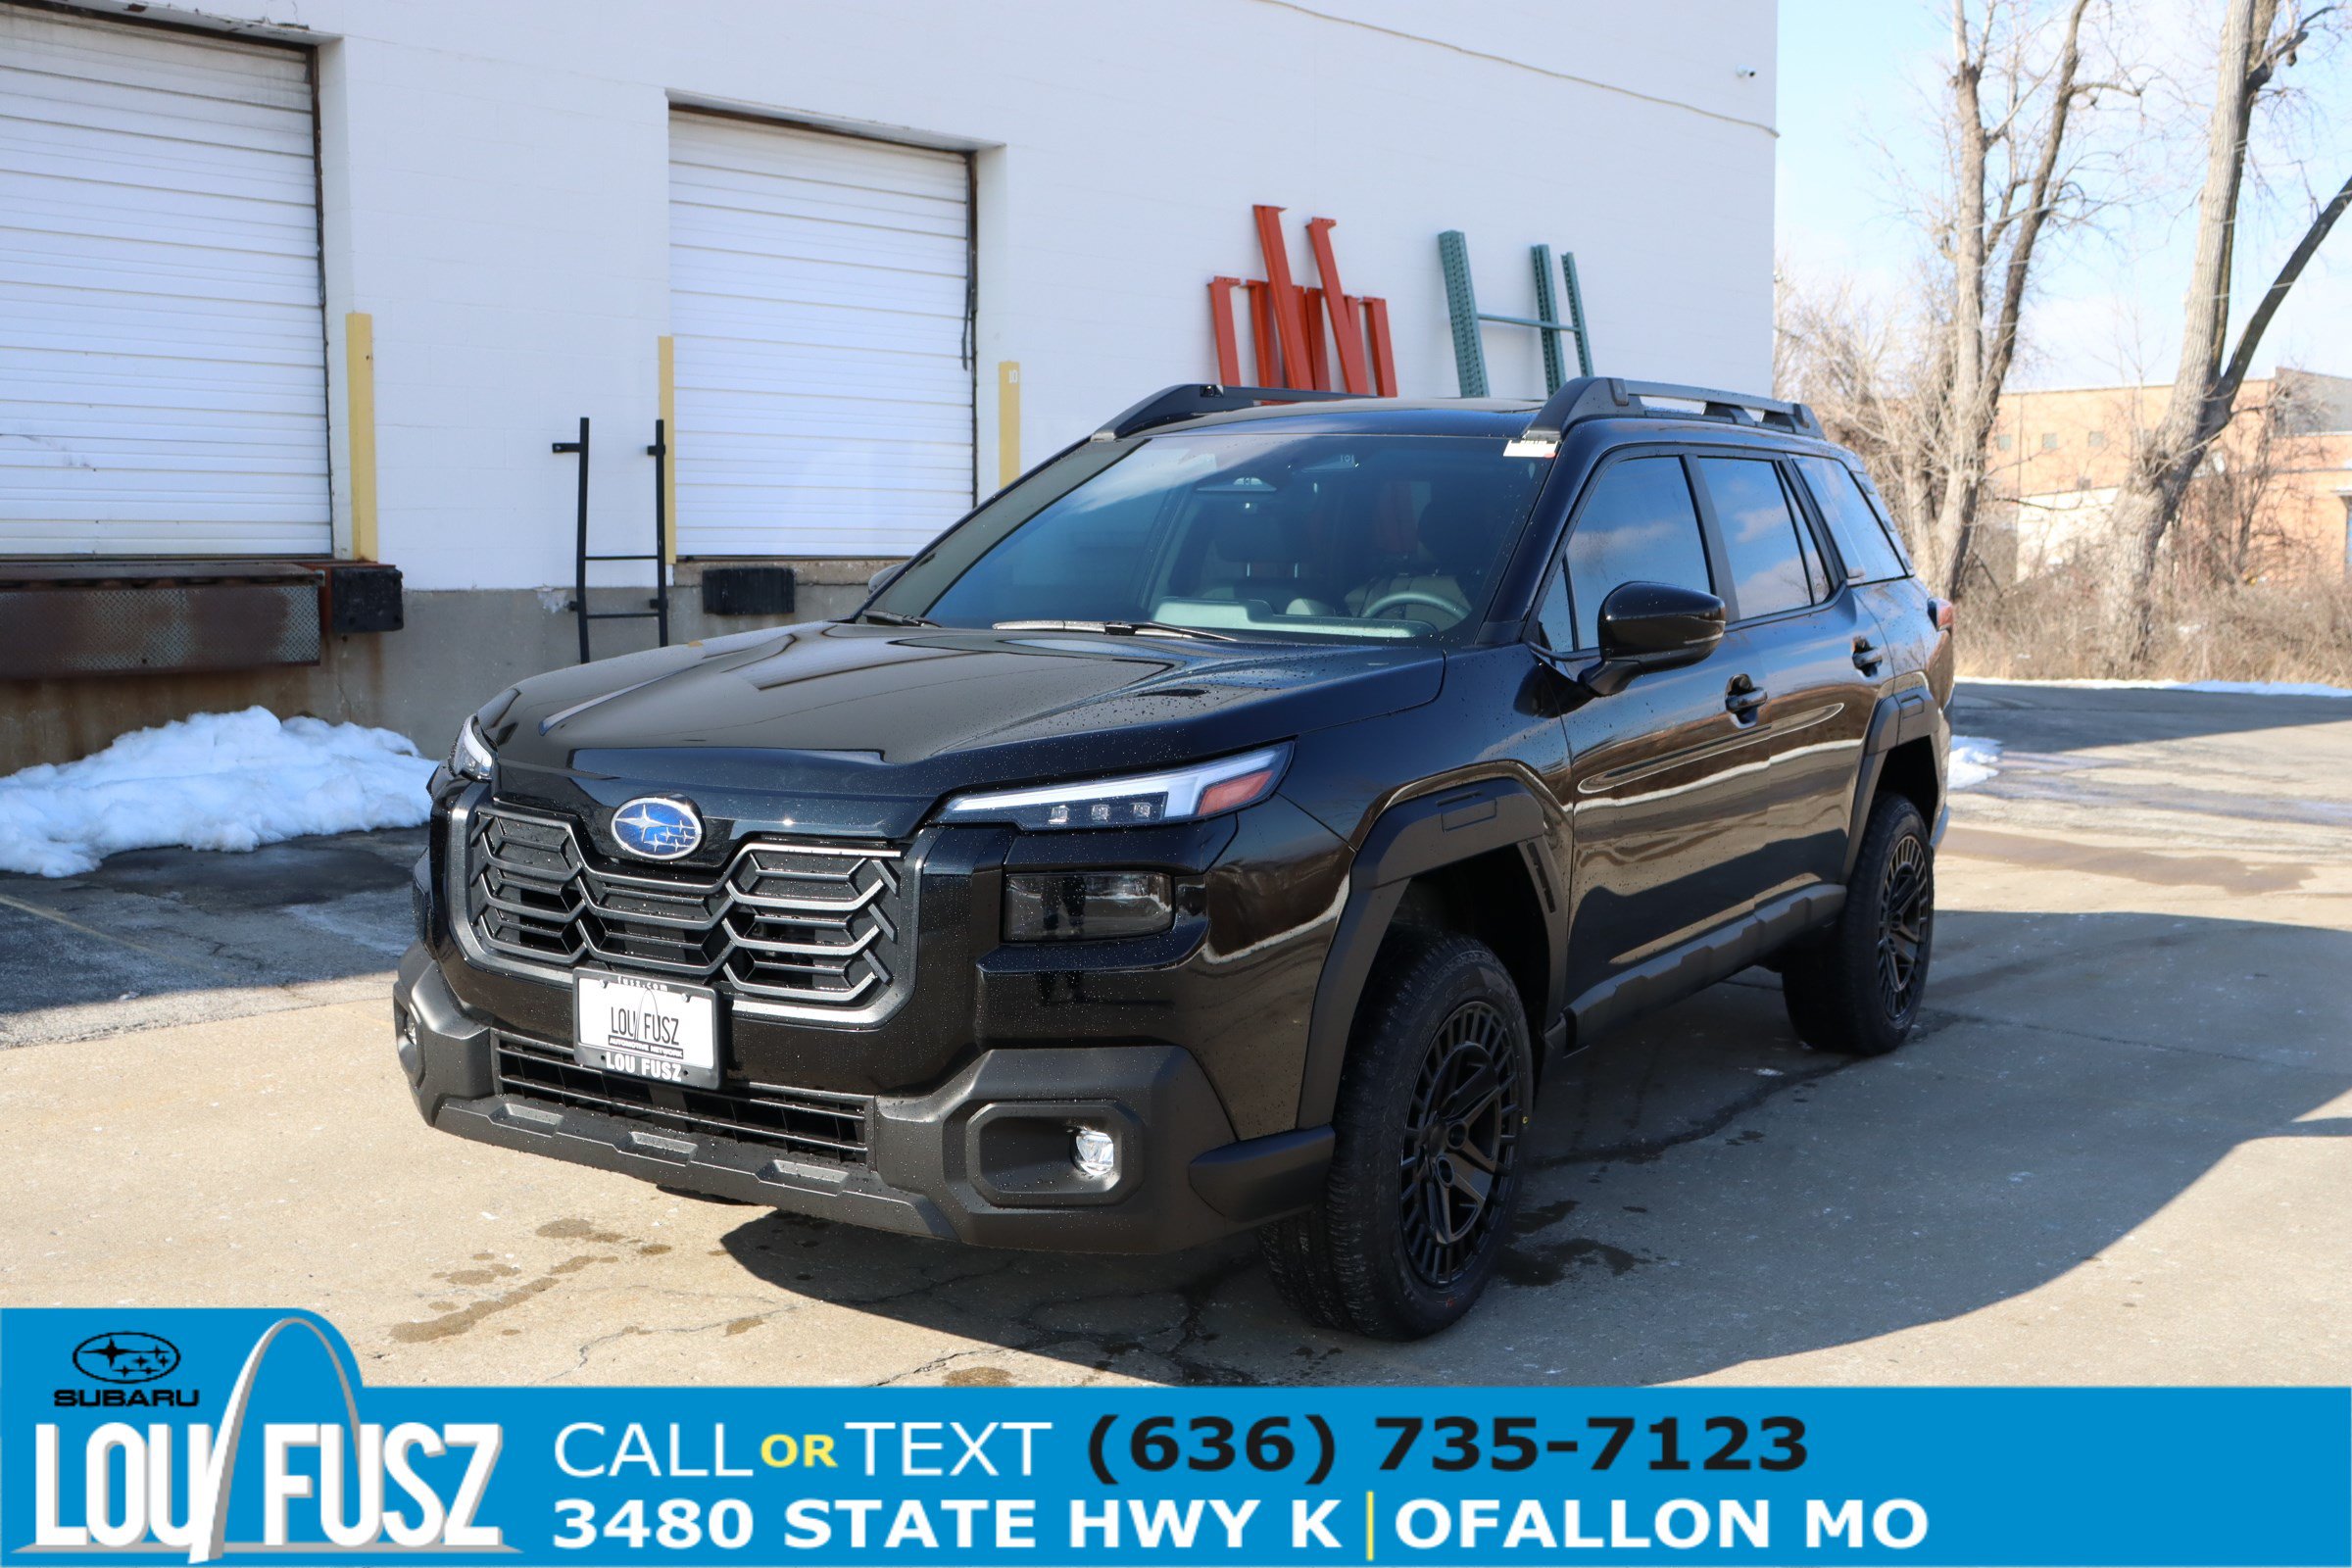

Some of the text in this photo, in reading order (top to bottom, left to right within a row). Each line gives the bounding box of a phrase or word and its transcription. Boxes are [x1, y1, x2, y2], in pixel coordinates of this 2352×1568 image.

[611, 1006, 680, 1046] LOU FUSZ
[609, 1037, 683, 1058] AUTOMOTIVE NETWORK
[606, 1051, 682, 1083] LOU FUSZ
